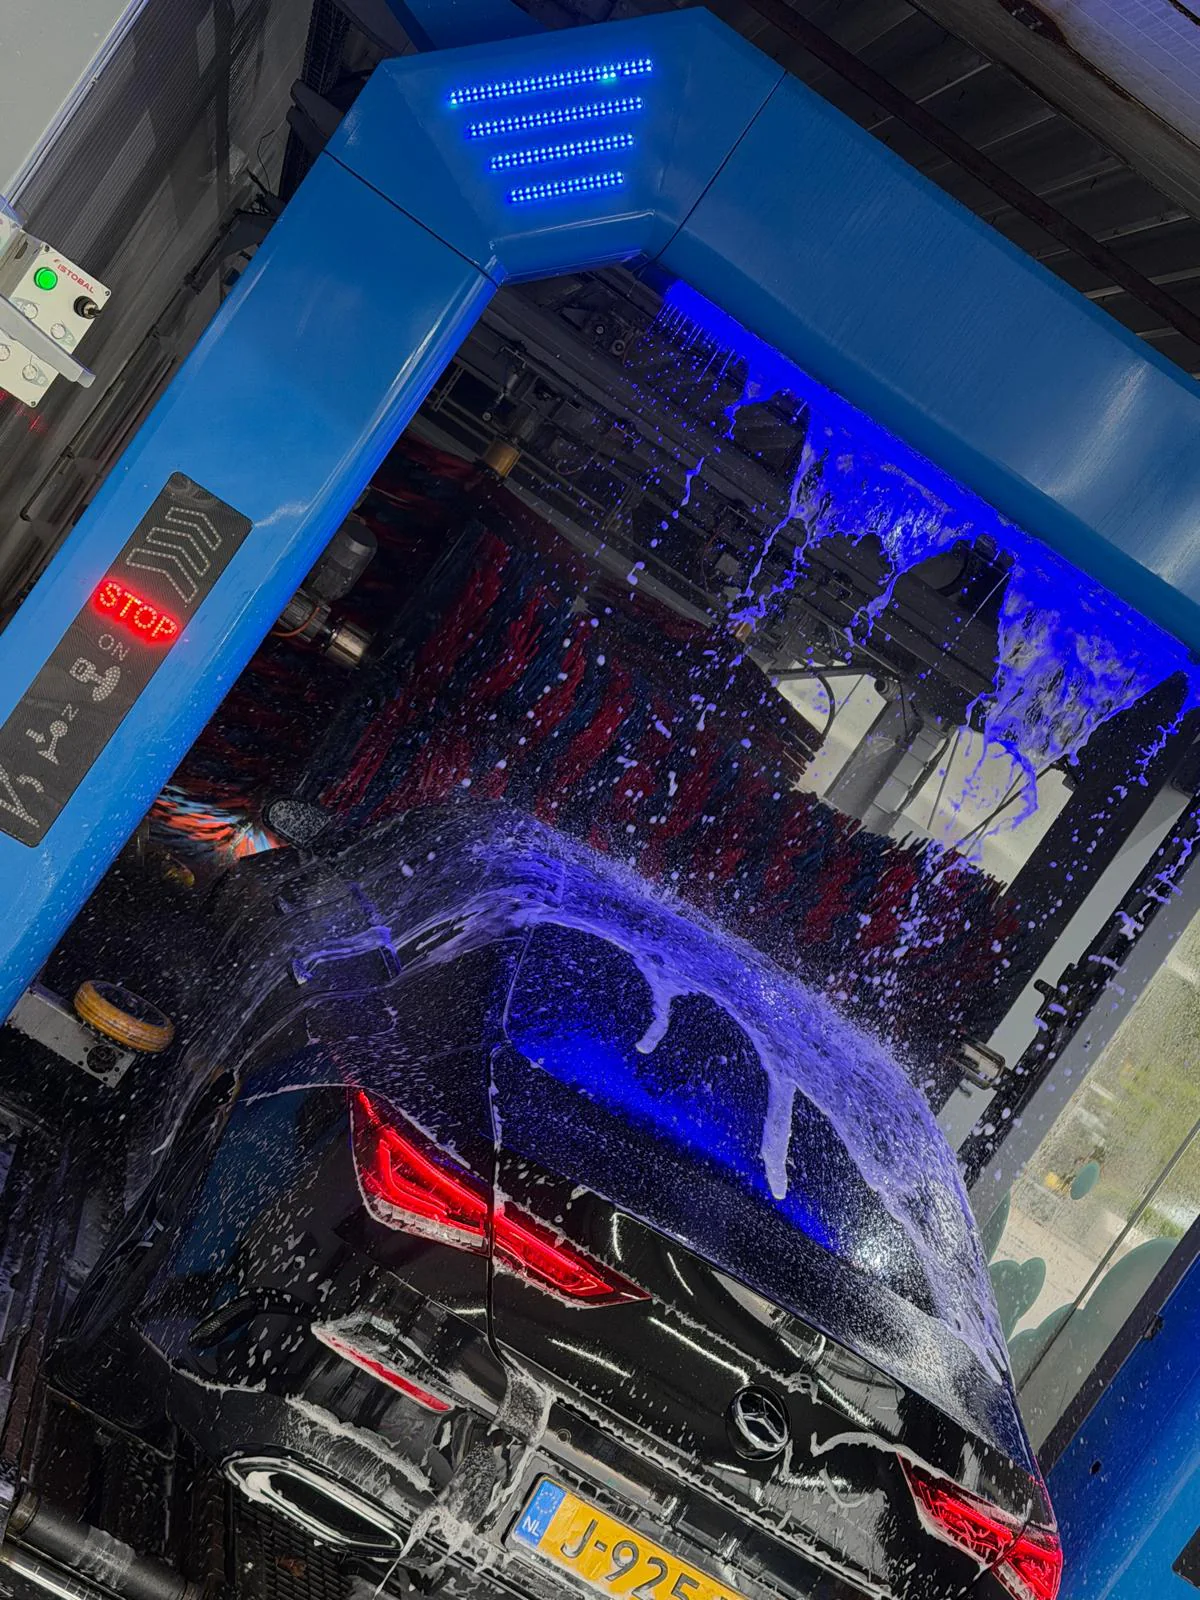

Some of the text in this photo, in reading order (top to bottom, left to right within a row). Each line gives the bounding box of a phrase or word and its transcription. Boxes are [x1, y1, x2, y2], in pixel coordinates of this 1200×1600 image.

[57, 264, 95, 294] ISTOBAL
[99, 581, 178, 638] STOP
[98, 633, 130, 661] ON
[61, 703, 80, 721] N
[521, 1515, 541, 1537] NL
